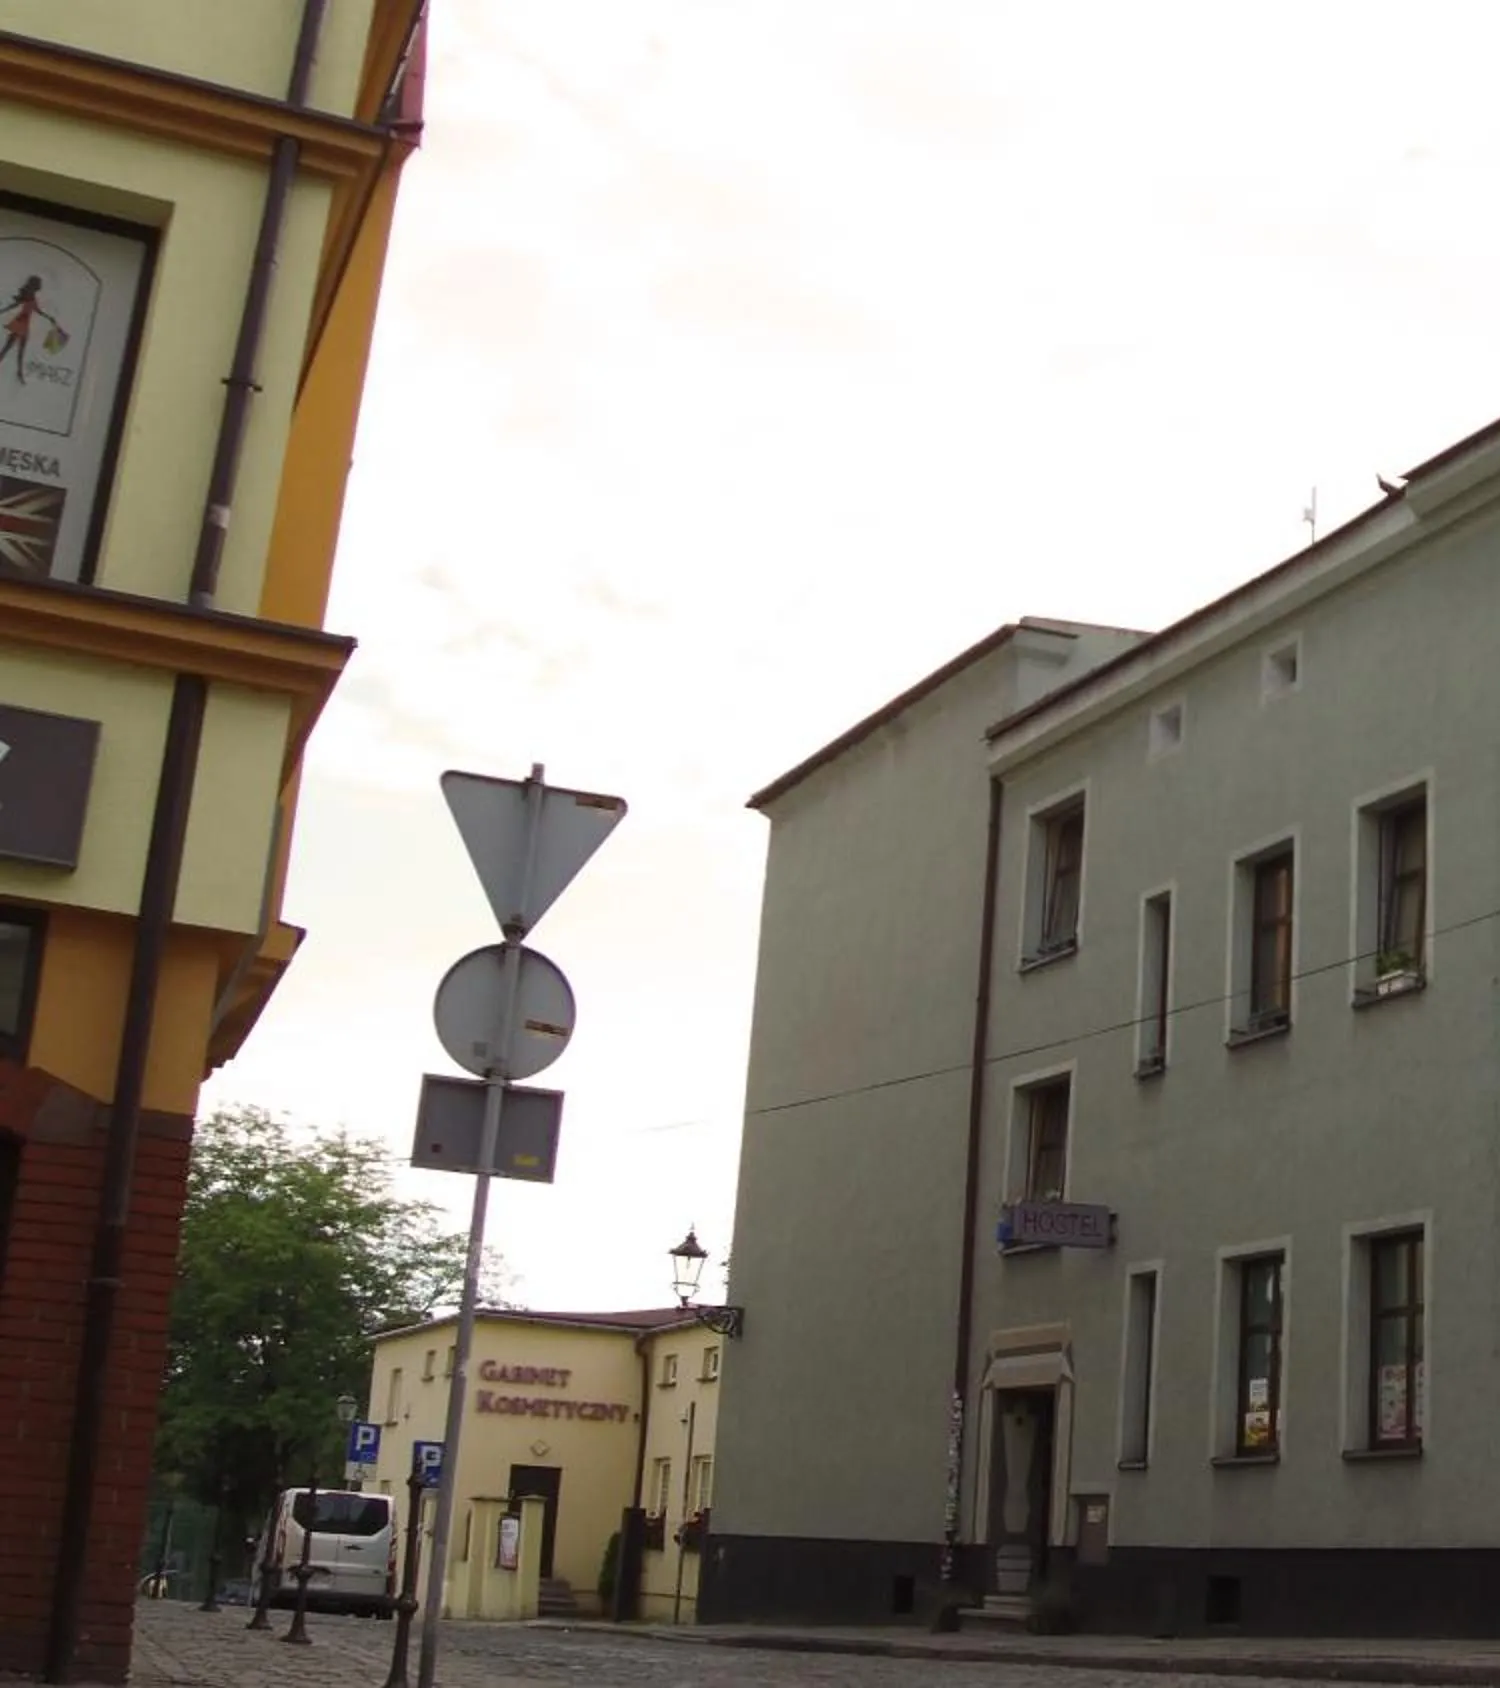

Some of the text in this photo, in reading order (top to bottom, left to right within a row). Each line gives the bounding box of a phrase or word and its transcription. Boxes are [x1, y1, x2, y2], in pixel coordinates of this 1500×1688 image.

[0, 447, 60, 477] ĘSKA
[1023, 1208, 1104, 1237] HOSTEL
[479, 1359, 572, 1388] GABINET
[475, 1390, 630, 1423] KOSMETYCZNY
[356, 1425, 376, 1451] P
